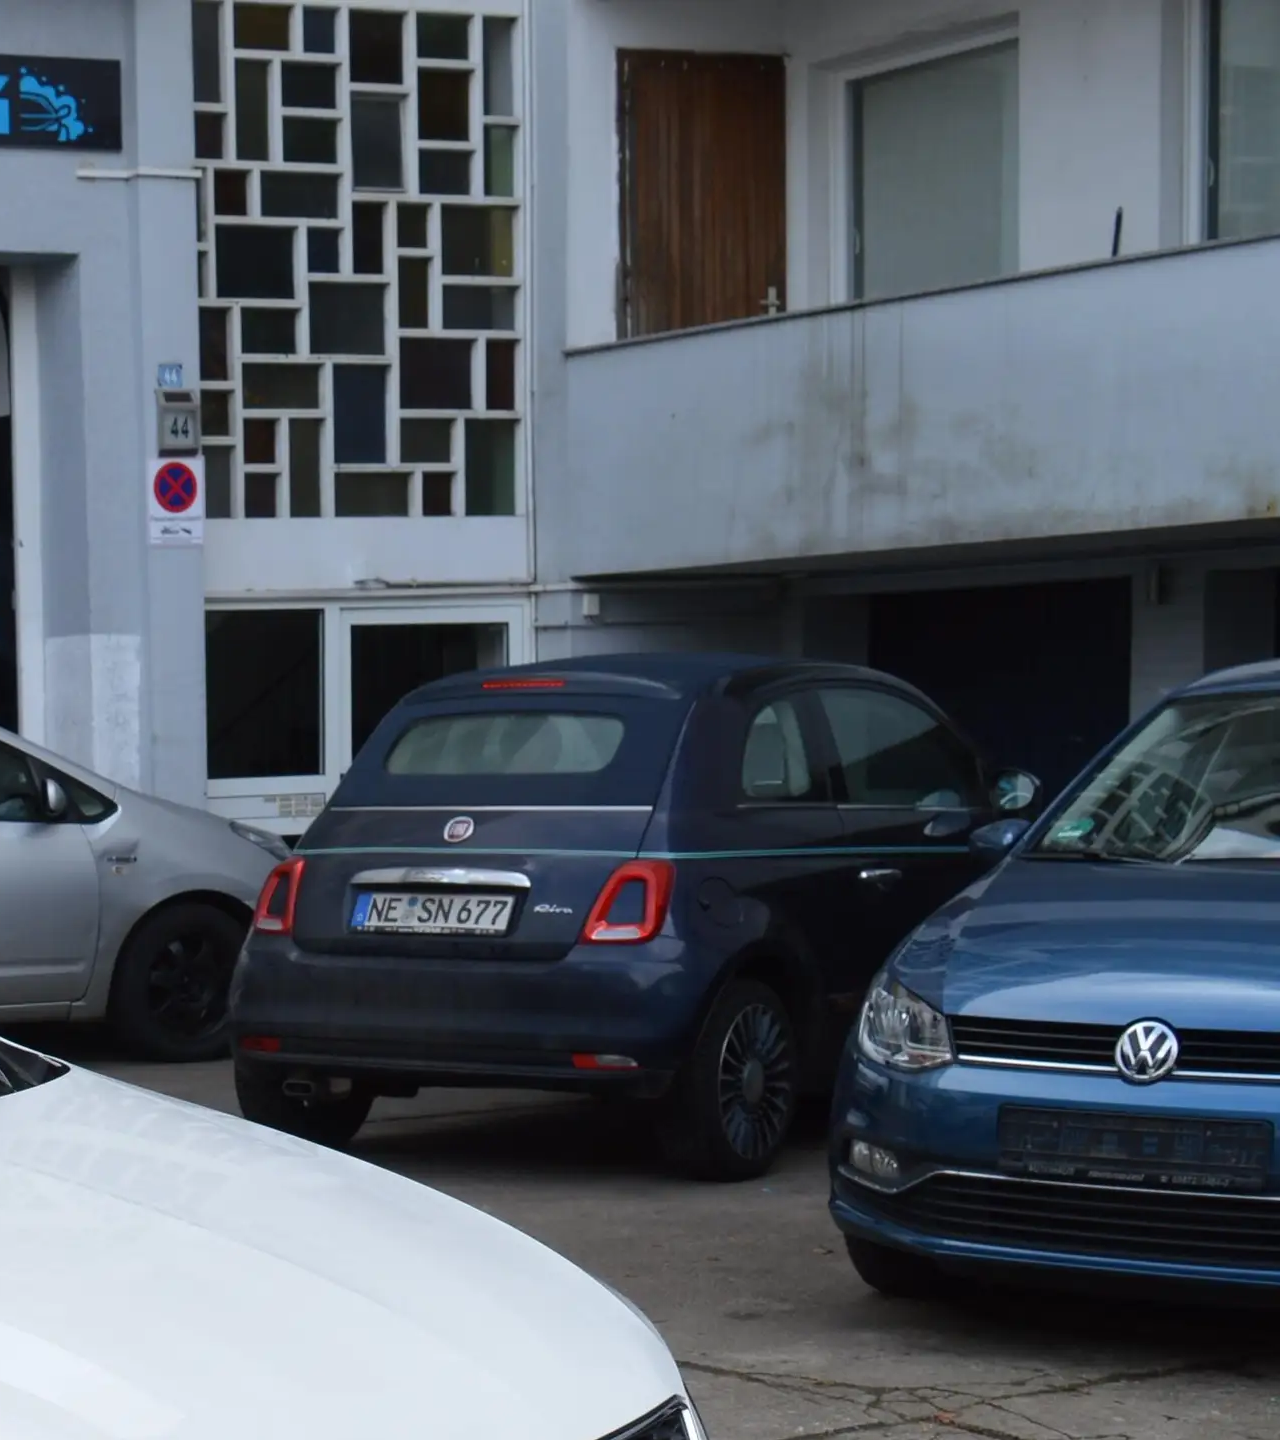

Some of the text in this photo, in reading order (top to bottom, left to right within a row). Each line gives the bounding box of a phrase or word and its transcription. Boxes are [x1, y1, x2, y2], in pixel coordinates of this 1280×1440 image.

[170, 416, 190, 440] 44
[367, 898, 401, 923] NE
[417, 897, 455, 924] SN
[456, 900, 509, 926] 677
